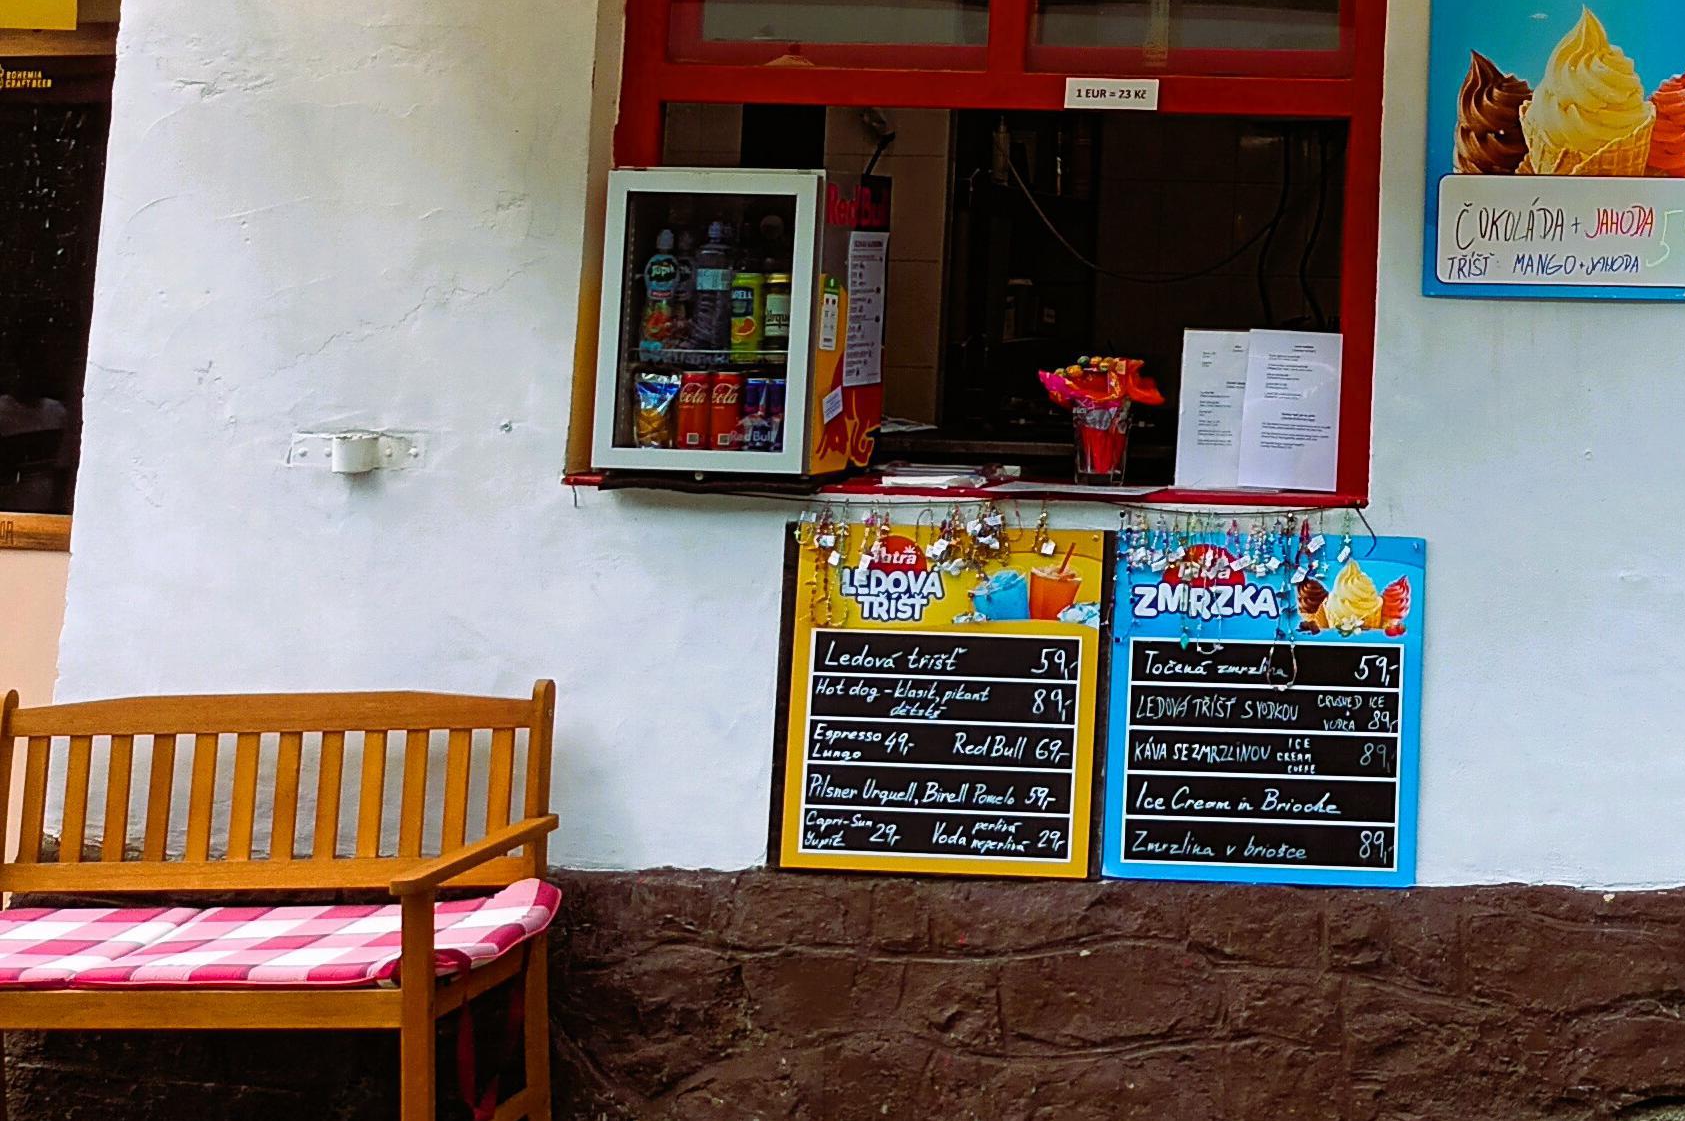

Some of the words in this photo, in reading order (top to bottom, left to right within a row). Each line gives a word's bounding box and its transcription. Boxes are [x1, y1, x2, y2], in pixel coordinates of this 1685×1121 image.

[1076, 88, 1082, 98] 1
[1085, 88, 1107, 98] EUR
[1118, 89, 1131, 99] 23
[1134, 89, 1147, 99] Kč
[1456, 197, 1565, 250] ČOKOLÁDA
[1585, 205, 1654, 239] JAHODA
[857, 591, 929, 620] TŘÍŠŤ
[1133, 582, 1279, 620] ZMRZKA
[824, 640, 903, 669] Ledová
[907, 646, 969, 671] tříšť
[1144, 650, 1213, 676] Točená
[816, 678, 845, 696] Hot
[849, 680, 881, 702] dog
[942, 683, 990, 703] pikant
[1136, 694, 1189, 720] LEDOVÁ
[1192, 693, 1237, 719] TŘÍŠŤ
[1240, 701, 1253, 719] S
[1256, 702, 1299, 721] VODKOU
[1369, 695, 1385, 708] ICE
[812, 743, 862, 762] Lungo
[814, 722, 882, 745] Espresso
[953, 732, 987, 757] Red
[990, 736, 1028, 760] Bull
[1134, 736, 1168, 763] KÁVA
[1173, 746, 1188, 762] SE
[1288, 738, 1311, 749] ICE
[1277, 751, 1312, 763] CREAM
[808, 773, 858, 800] Pilsner
[862, 778, 919, 806] Urquell,
[922, 781, 970, 805] Birell
[972, 783, 1016, 806] Pomelo
[1136, 781, 1166, 811] Ice
[1171, 785, 1231, 811] Cream
[1237, 797, 1254, 811] in
[1261, 788, 1342, 816] Brioche
[805, 811, 873, 832] Capri-Sun
[931, 821, 967, 846] Voda
[1131, 830, 1215, 857] Zmrzlina
[1226, 845, 1237, 857] v
[1244, 835, 1308, 860] briošce
